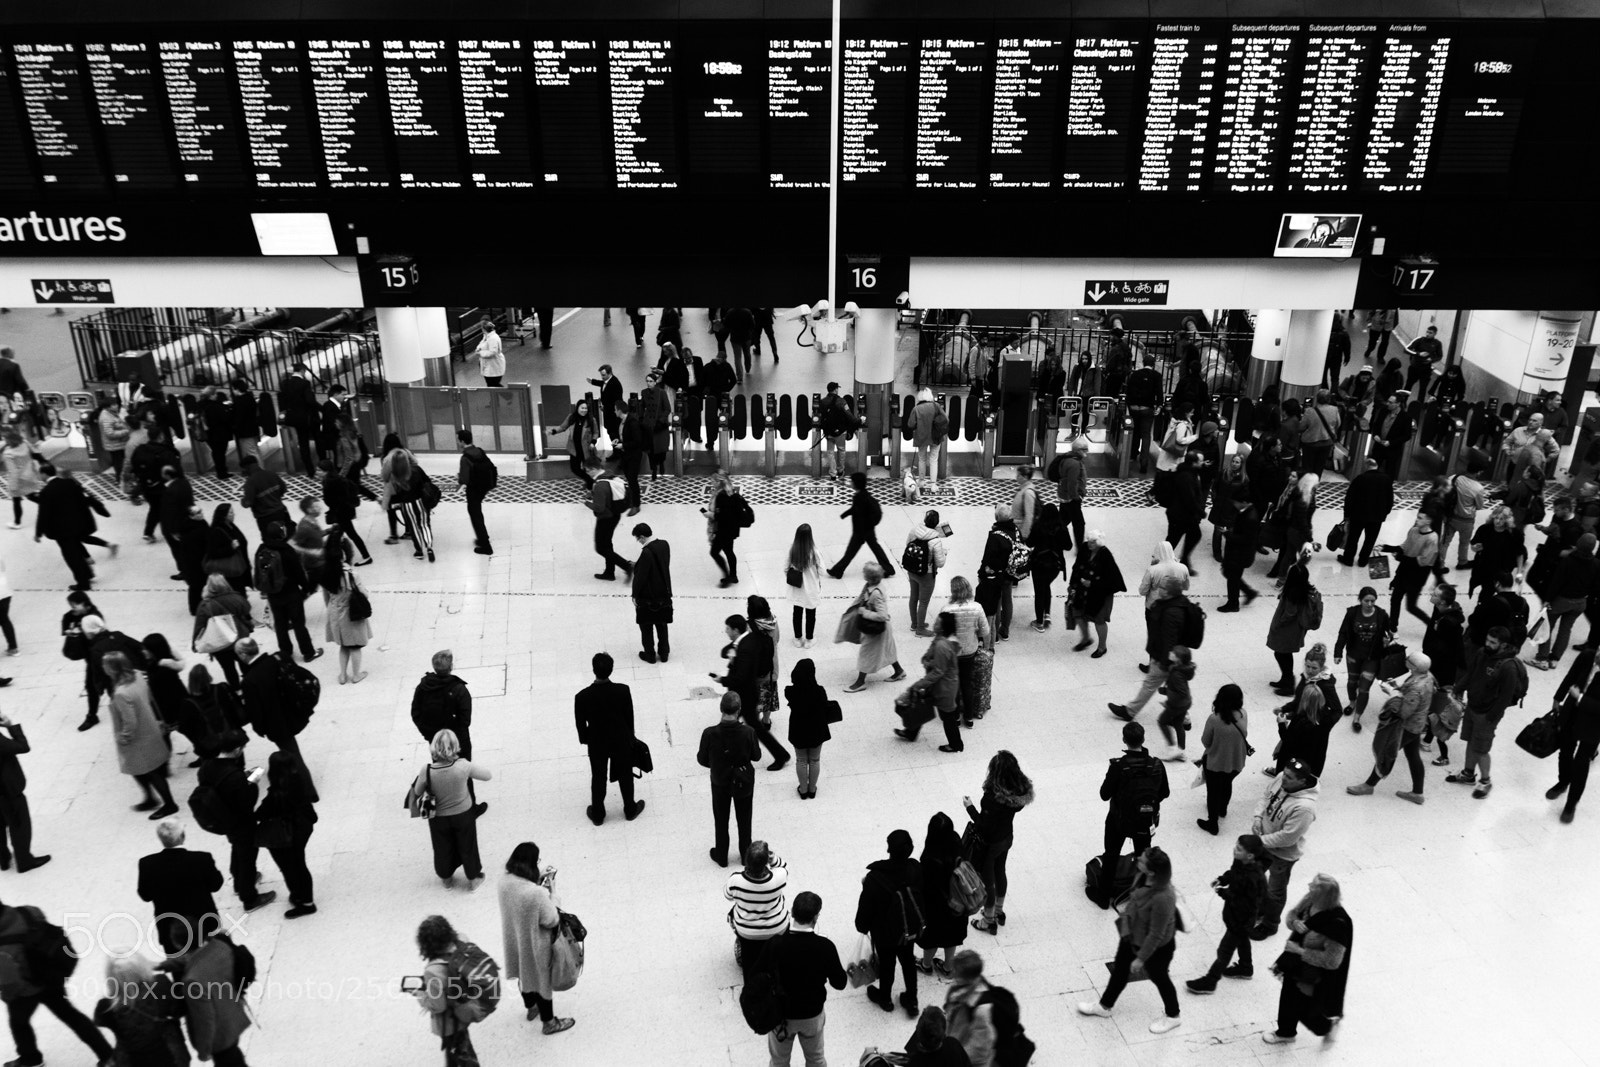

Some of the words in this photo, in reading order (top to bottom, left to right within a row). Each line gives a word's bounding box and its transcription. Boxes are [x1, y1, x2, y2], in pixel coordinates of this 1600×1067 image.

[1232, 24, 1267, 32] Subsequent
[1309, 24, 1345, 32] Subsequent
[458, 40, 478, 48] 19:07
[482, 40, 510, 48] Platform
[562, 40, 590, 49] Platform
[609, 40, 629, 49] 19:09
[633, 41, 661, 49] Platform
[770, 40, 789, 48] 19:12
[794, 40, 821, 48] Platform
[824, 40, 831, 48] 10
[846, 40, 865, 48] 19:12
[870, 40, 898, 48] Platform
[922, 40, 942, 48] 19:15
[999, 39, 1018, 47] 19:15
[1023, 39, 1052, 47] Platform
[1076, 39, 1096, 47] 19:17
[1100, 39, 1128, 47] Platform
[234, 51, 262, 60] Reading
[383, 51, 414, 59] Hampton
[769, 50, 812, 59] Basingstoke
[845, 50, 886, 59] Shepperton
[997, 49, 1029, 57] Hounslow
[1074, 49, 1117, 58] Chessington
[1120, 49, 1132, 57] Sth
[0, 211, 126, 241] artures
[381, 267, 406, 287] 15
[409, 264, 419, 285] 15
[852, 268, 876, 288] 16
[1392, 265, 1405, 287] 17
[1410, 269, 1434, 290] 17
[1547, 338, 1574, 348] 19-20
